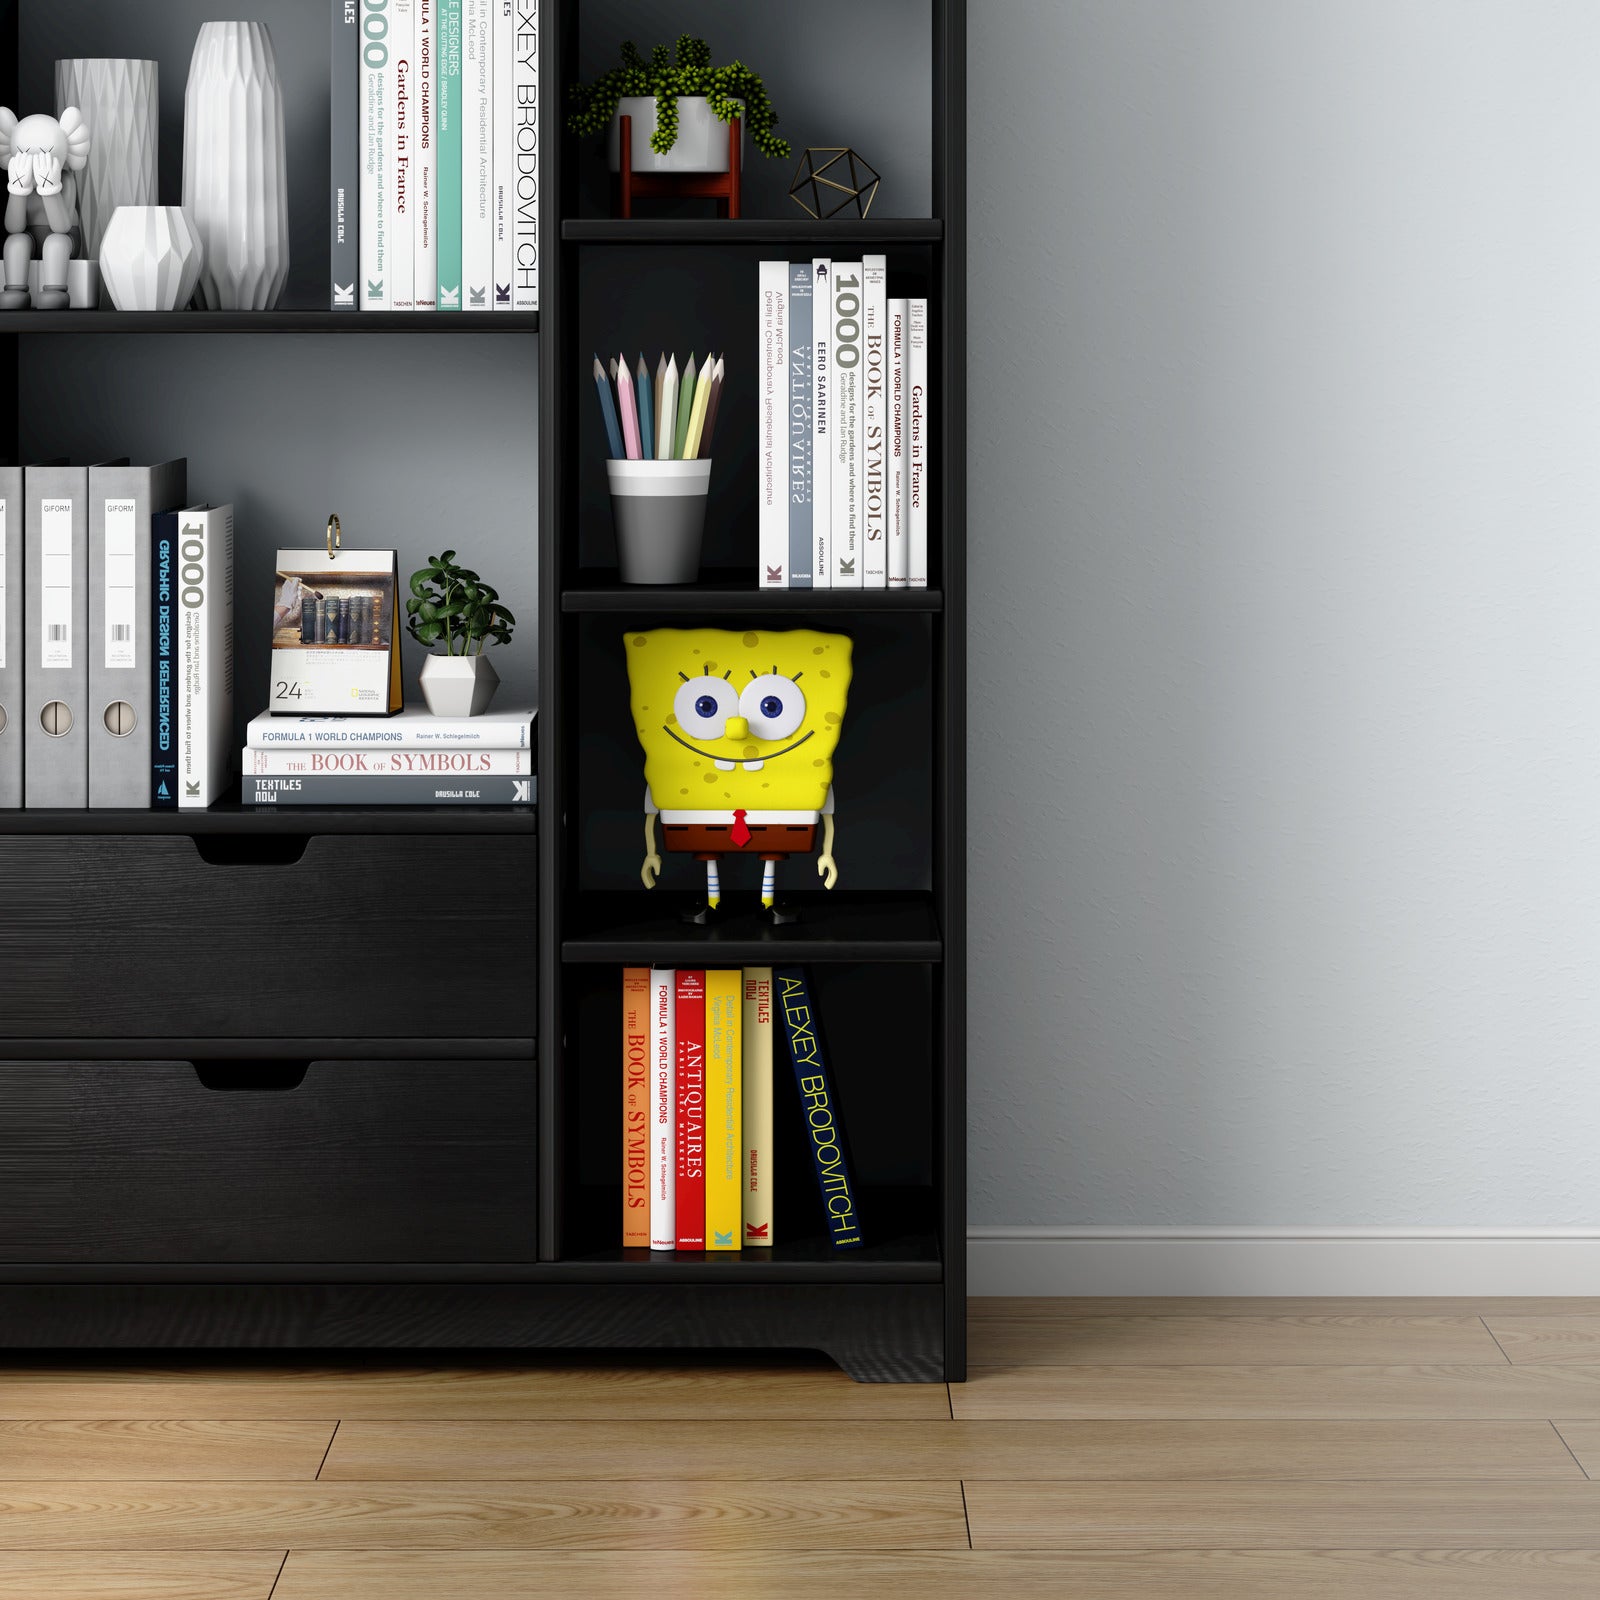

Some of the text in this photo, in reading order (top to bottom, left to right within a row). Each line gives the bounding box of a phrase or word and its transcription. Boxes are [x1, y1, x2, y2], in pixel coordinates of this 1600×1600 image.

[441, 8, 447, 16] AT
[480, 9, 487, 17] in
[440, 32, 448, 57] CUTTING
[449, 13, 459, 76] DESIGNERS
[478, 21, 487, 94] Contemporary
[376, 73, 384, 105] designs
[398, 60, 408, 213] Gardens in France
[376, 137, 384, 171] gardens
[517, 85, 536, 288] BRODOVITCH
[378, 220, 383, 228] to
[836, 274, 859, 368] 1000
[868, 335, 881, 400] BOOK
[818, 342, 826, 433] EERO SAARINEN
[848, 372, 856, 401] designs
[868, 406, 874, 419] OF
[839, 440, 847, 463] Rudge
[848, 430, 856, 461] gardens
[913, 386, 922, 508] Gardens in France
[868, 427, 881, 541] SYMBOLS
[849, 504, 855, 512] to
[276, 682, 302, 699] 24
[263, 733, 305, 741] FORMULA
[315, 733, 347, 741] WORLD
[350, 733, 402, 741] CHAMPIONS
[287, 763, 306, 771] THE
[312, 754, 368, 770] BOOK
[391, 754, 490, 770] SYMBOLS
[256, 780, 301, 790] TEXTILES
[256, 791, 276, 802] NOW
[659, 985, 667, 1027] FORMULA
[726, 995, 735, 1018] Detail
[744, 978, 758, 1001] NOW
[757, 978, 770, 1025] TEXTILES
[779, 977, 820, 1067] ALEXEY
[659, 1037, 667, 1069] WORLD
[713, 1028, 722, 1059] McLeod
[724, 1029, 735, 1085] Contemporary
[628, 1010, 645, 1208] THE BOOK OF SYMBOLS
[659, 1072, 667, 1123] CHAMPIONS
[686, 1041, 702, 1177] ANTIQUAIRES
[726, 1087, 735, 1130] Residential
[726, 1133, 734, 1180] Architecture
[801, 1076, 855, 1232] BRODOVITCH
